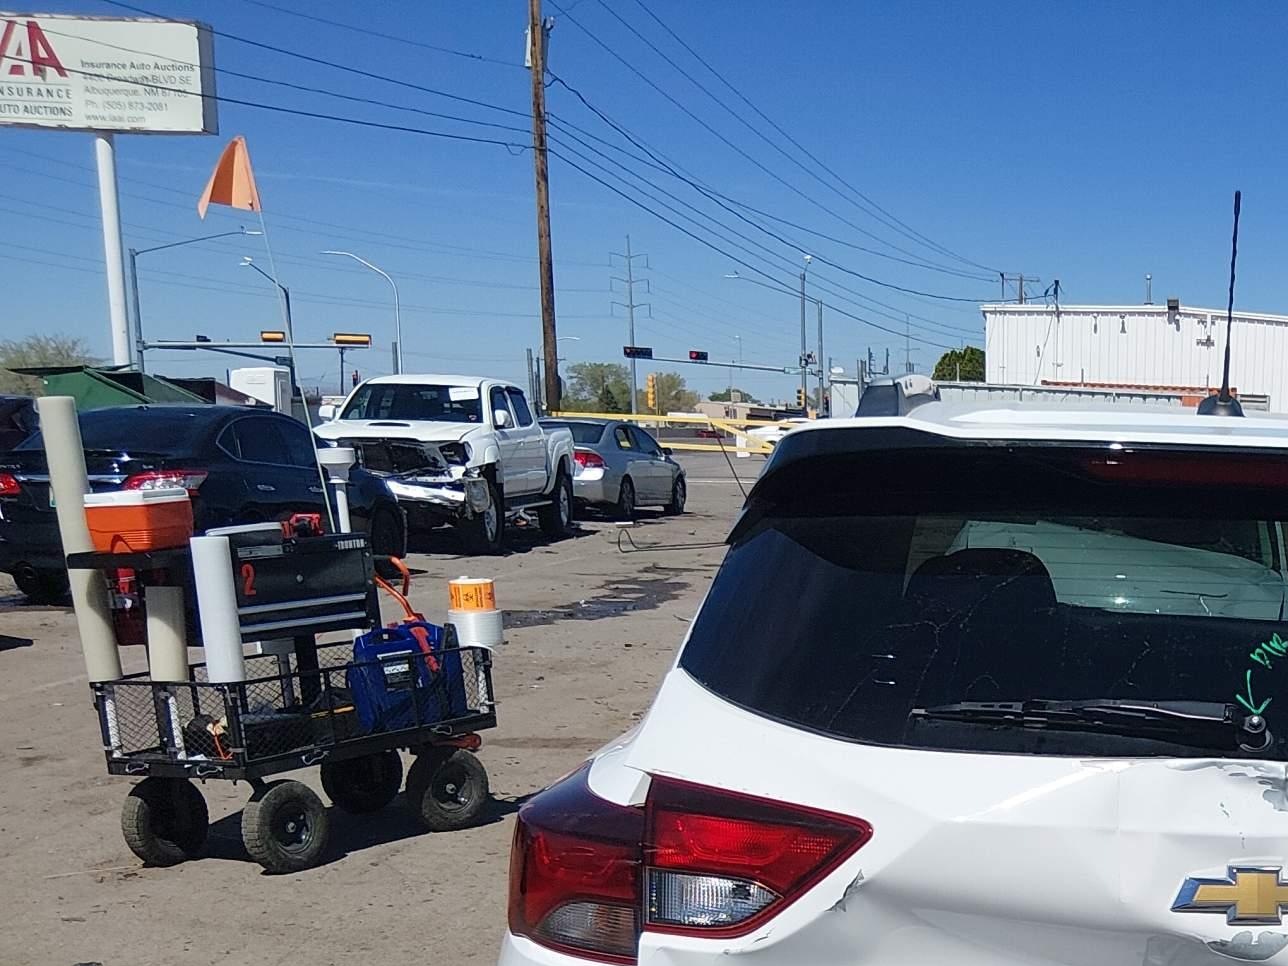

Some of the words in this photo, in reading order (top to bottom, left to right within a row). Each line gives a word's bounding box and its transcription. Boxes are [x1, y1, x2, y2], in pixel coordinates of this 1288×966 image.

[80, 60, 127, 70] Insurance
[129, 61, 152, 71] Auto
[153, 62, 195, 72] Auctions
[178, 75, 193, 86] SE
[0, 86, 72, 99] NSURANCE
[0, 103, 20, 114] UTO
[23, 104, 73, 117] AUCTIONS
